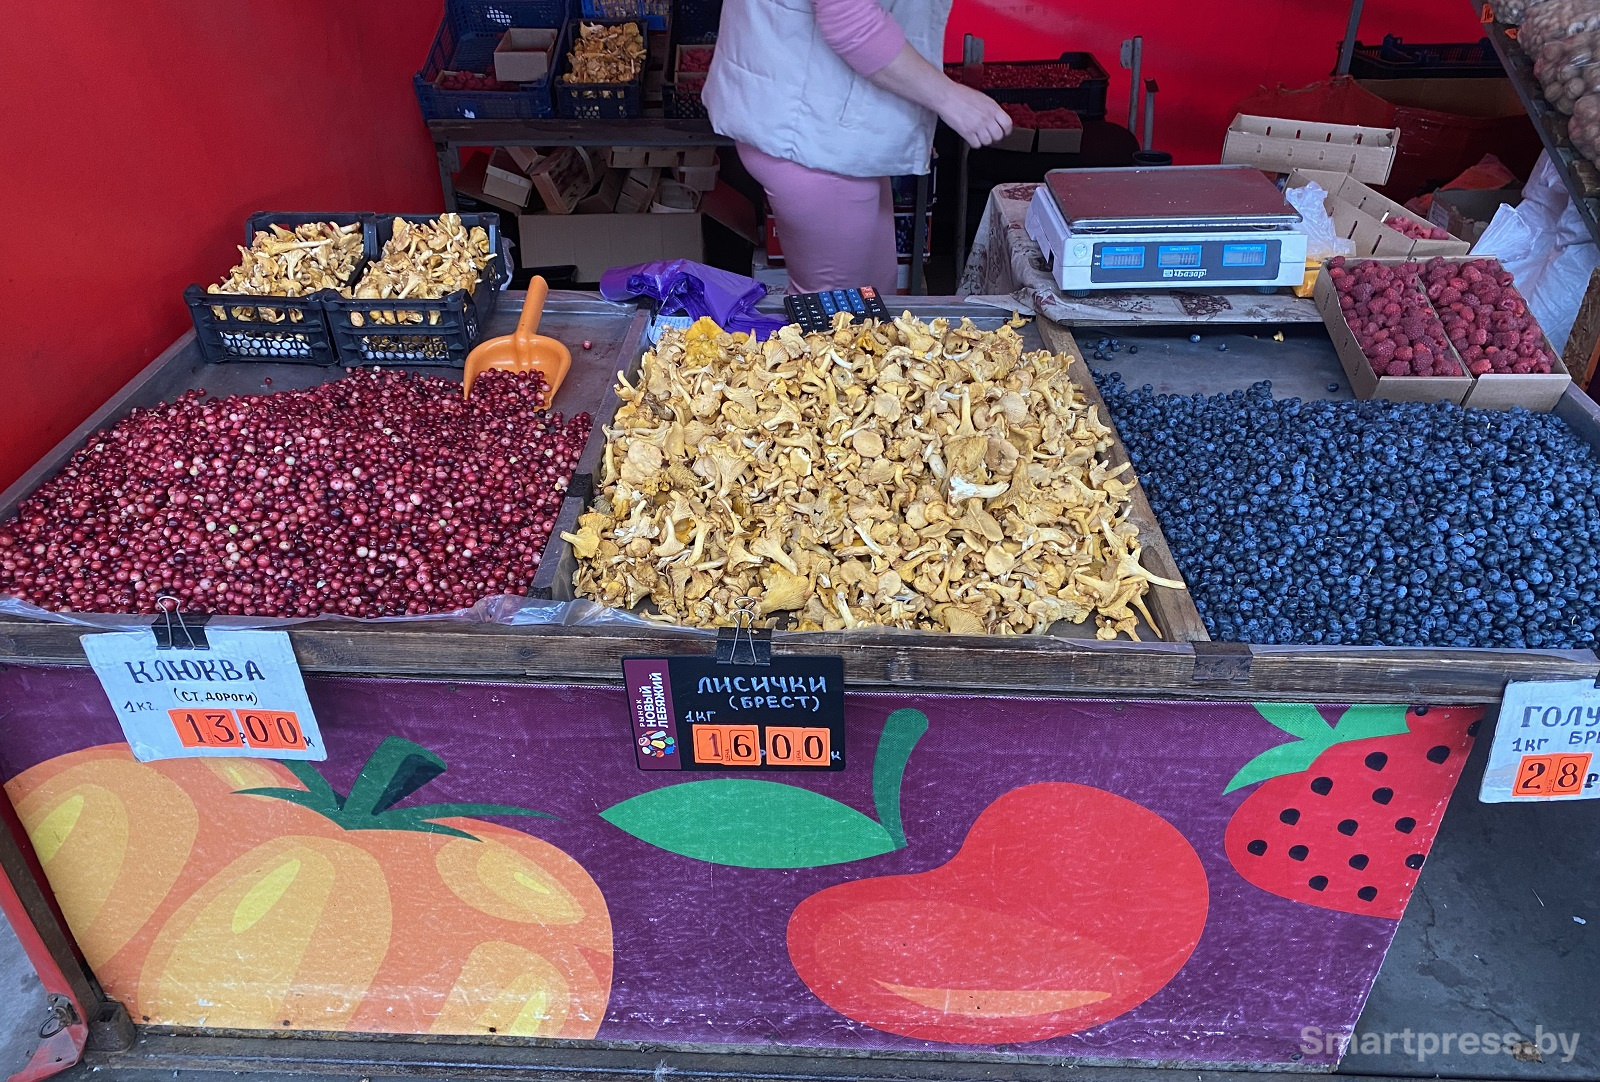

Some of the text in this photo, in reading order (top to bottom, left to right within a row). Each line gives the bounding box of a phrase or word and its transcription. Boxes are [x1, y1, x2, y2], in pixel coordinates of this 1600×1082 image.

[124, 659, 266, 684] КЛЮКВА
[696, 675, 828, 694] ЛИСИЧКИ
[636, 699, 646, 728] РЫНОК
[639, 685, 657, 728] НОВЫЙ
[649, 672, 669, 729] ЛЕБЯЖИЙ
[728, 695, 820, 712] (БРЕСТ)
[1522, 762, 1578, 789] 28
